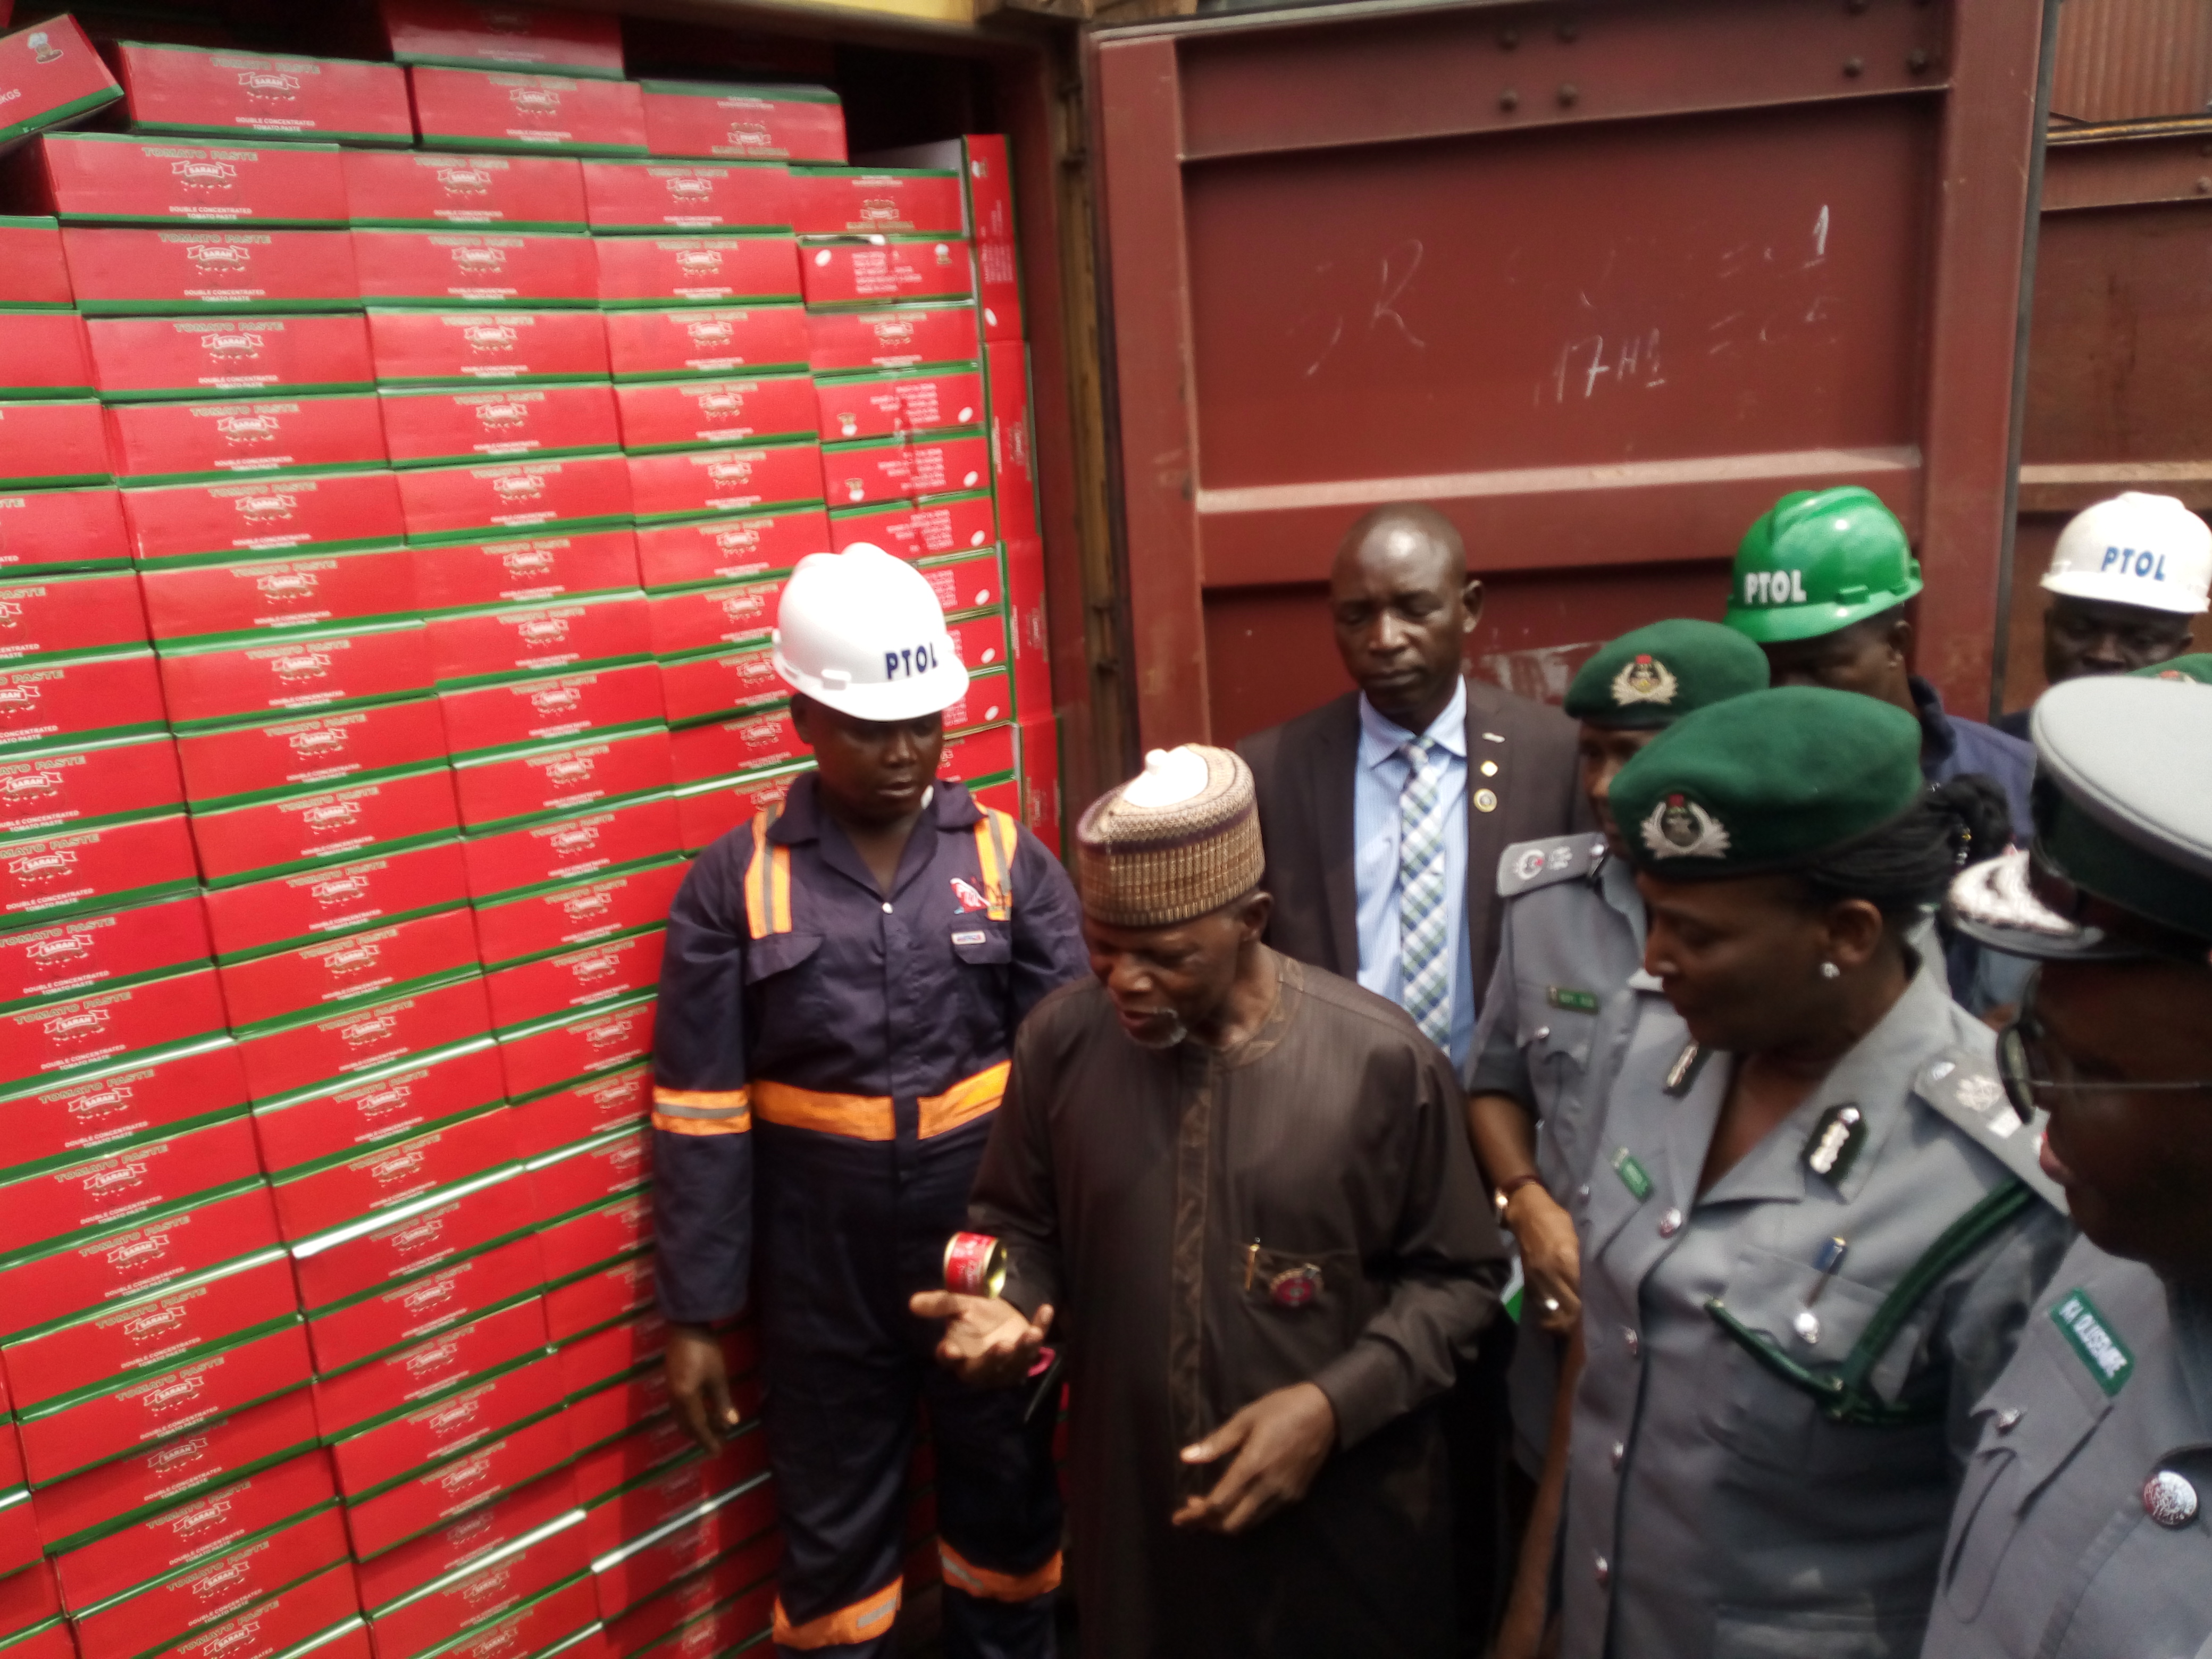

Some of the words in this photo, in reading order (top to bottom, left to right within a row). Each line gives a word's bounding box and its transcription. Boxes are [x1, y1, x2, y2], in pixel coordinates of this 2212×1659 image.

[142, 148, 207, 158] TOMATO
[210, 151, 258, 160] PASTE
[159, 233, 222, 242] TOMATO
[2101, 546, 2166, 582] PTOL
[1744, 569, 1807, 605] PTOL
[886, 642, 938, 680] PTOL
[1, 691, 21, 699] RAH
[0, 763, 31, 775] ATO
[35, 756, 86, 769] PASTE
[13, 776, 44, 786] SARAH
[0, 842, 46, 857] MATO
[49, 834, 100, 848] PASTE
[28, 856, 58, 866] SARAH
[66, 917, 115, 933] PASTE
[46, 940, 75, 951] SARAH
[14, 1004, 79, 1025] TOMATO
[83, 992, 131, 1009] PASTE
[62, 1016, 91, 1028] SARAH
[39, 1082, 103, 1104] TOMATO
[106, 1070, 154, 1087] PASTE
[86, 1094, 114, 1107] SARAH
[55, 1159, 118, 1183] TOMATO
[121, 1145, 168, 1164] PASTE
[101, 1170, 129, 1183] SARAH
[115, 1374, 177, 1400] TOMATO
[180, 1358, 223, 1378] PASTE
[160, 1384, 187, 1398] SARAH
[165, 1445, 191, 1460] SARAH
[147, 1500, 205, 1529] TOMATO
[208, 1481, 250, 1504] PASTE
[189, 1509, 215, 1524] SARAH
[167, 1561, 224, 1591] TOMATO
[228, 1541, 269, 1565] PASTE
[208, 1569, 234, 1585] SARAH
[219, 1631, 245, 1647] SARAH
